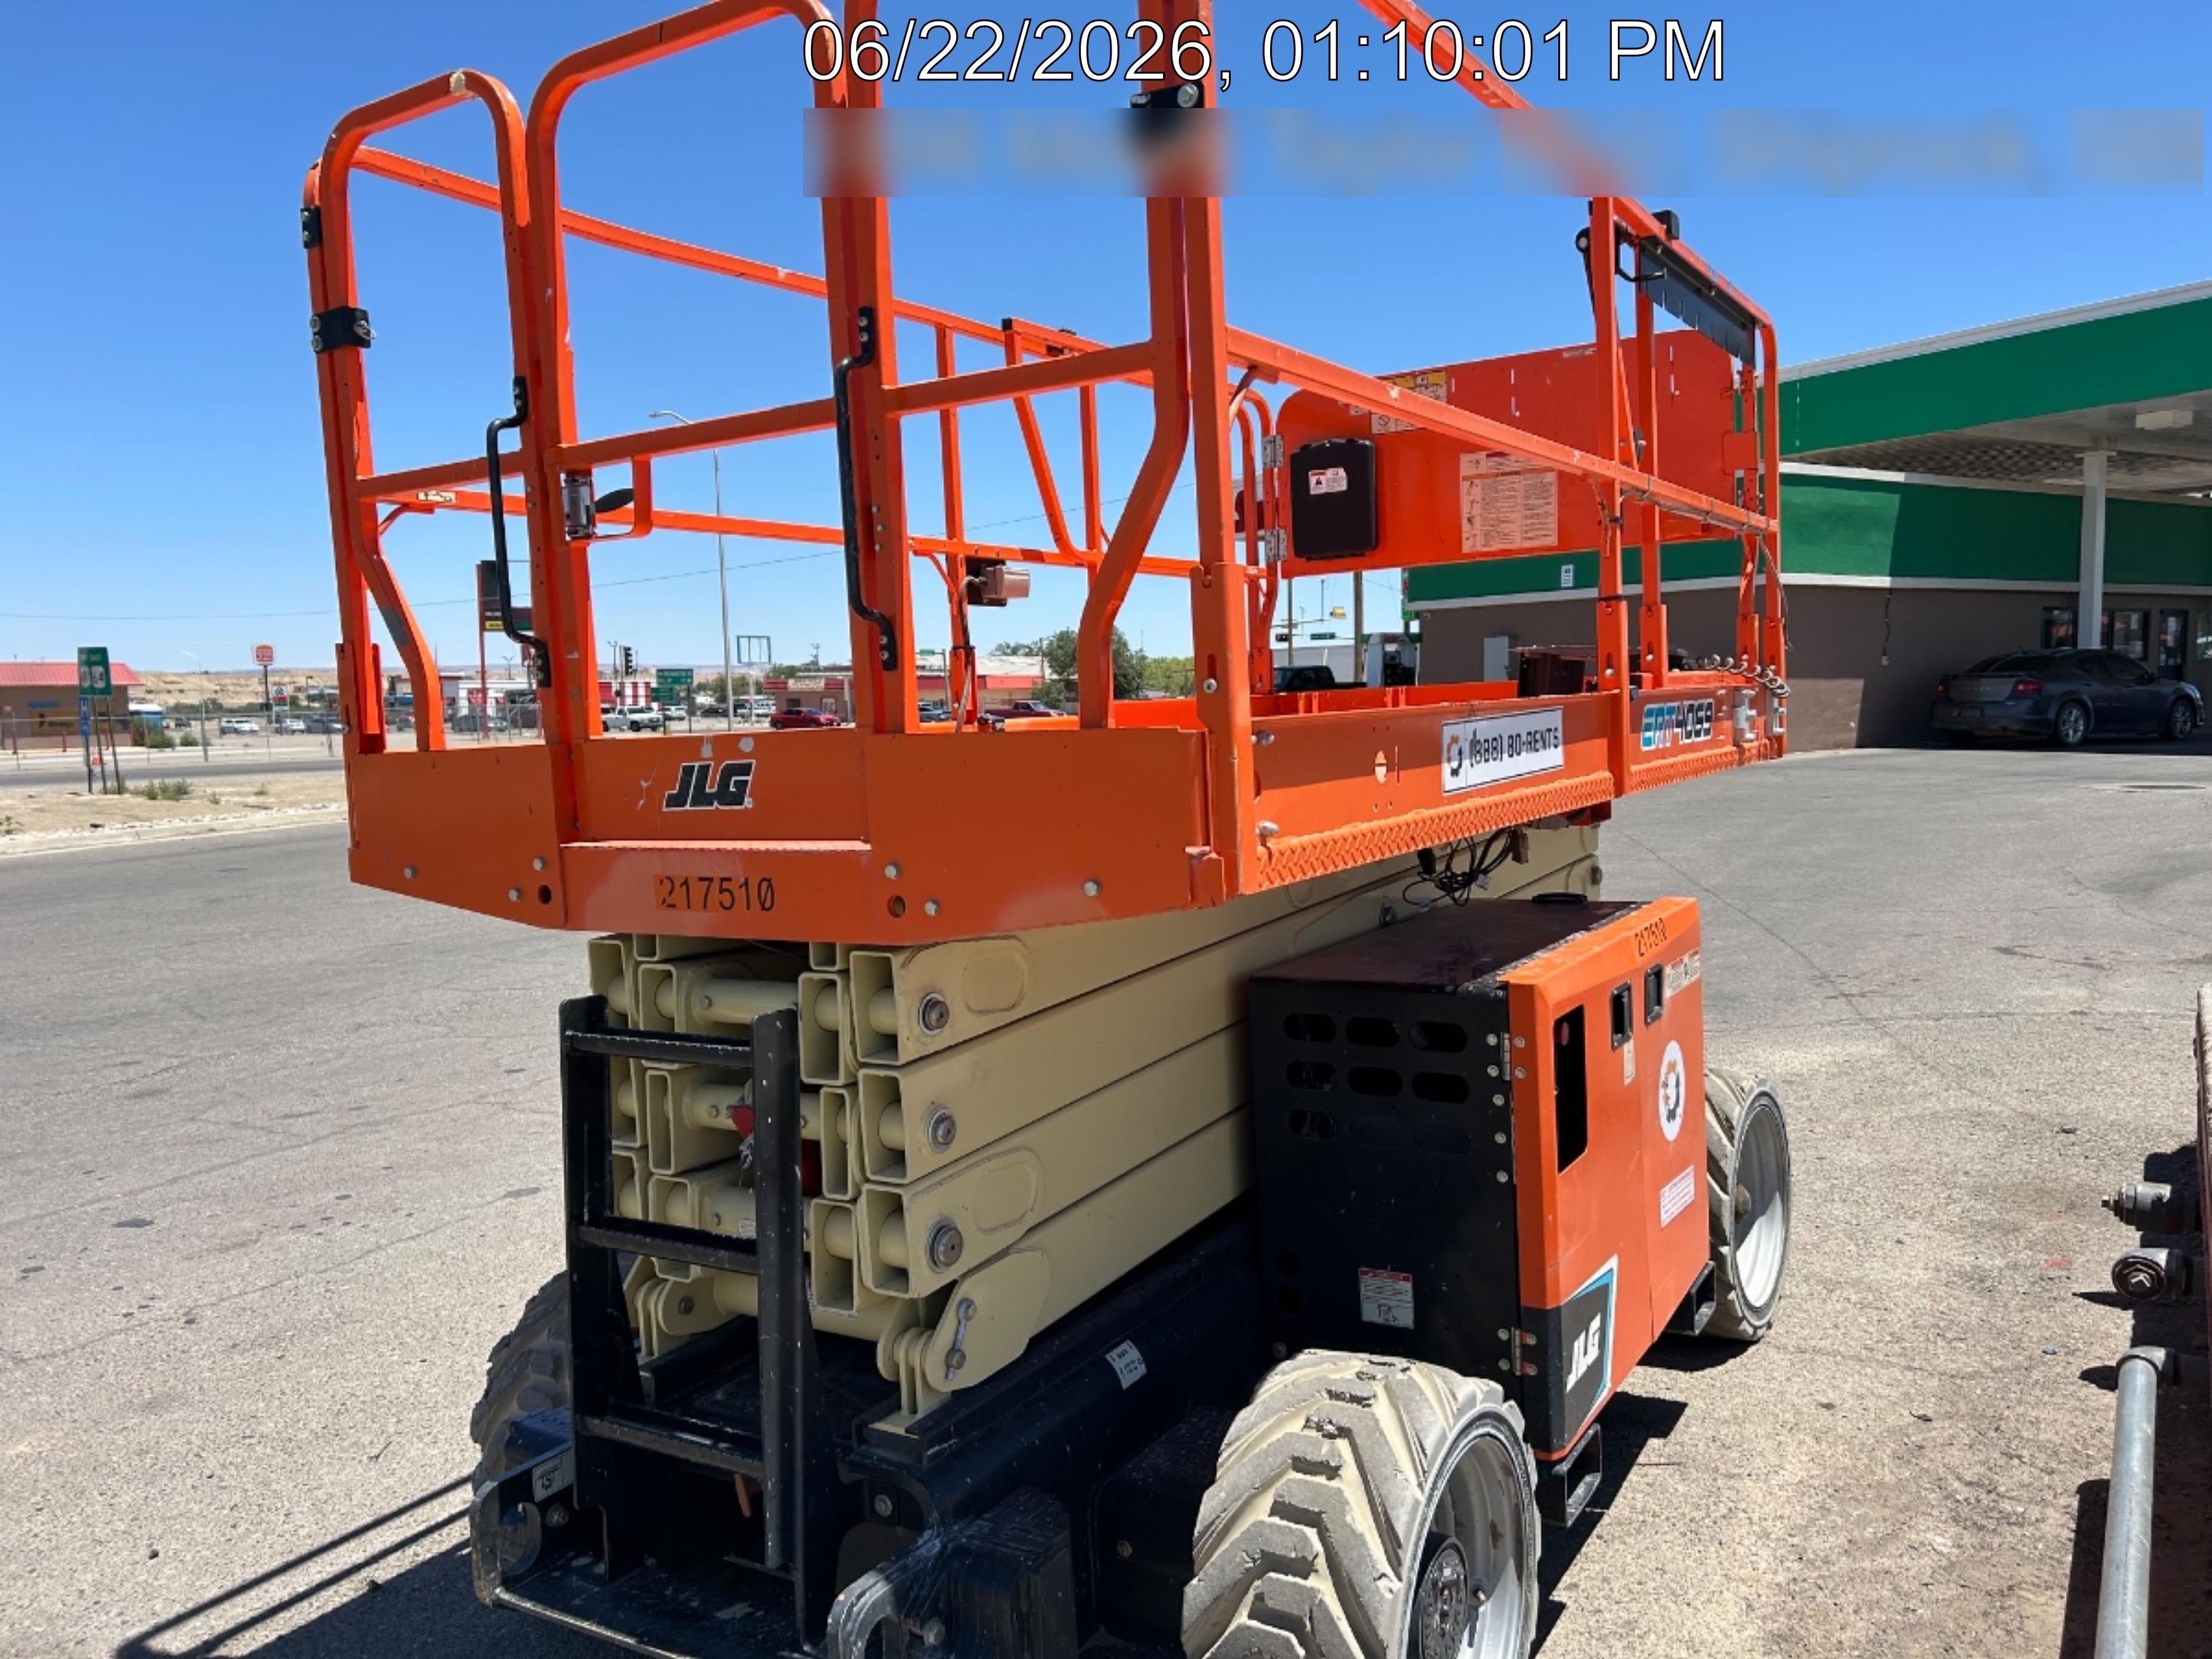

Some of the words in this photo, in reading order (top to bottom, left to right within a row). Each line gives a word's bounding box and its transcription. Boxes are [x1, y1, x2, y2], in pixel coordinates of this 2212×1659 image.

[1469, 729, 1503, 769] (888)
[662, 759, 756, 811] JLG
[659, 876, 775, 911] 217510
[1566, 1312, 1601, 1393] JLG
